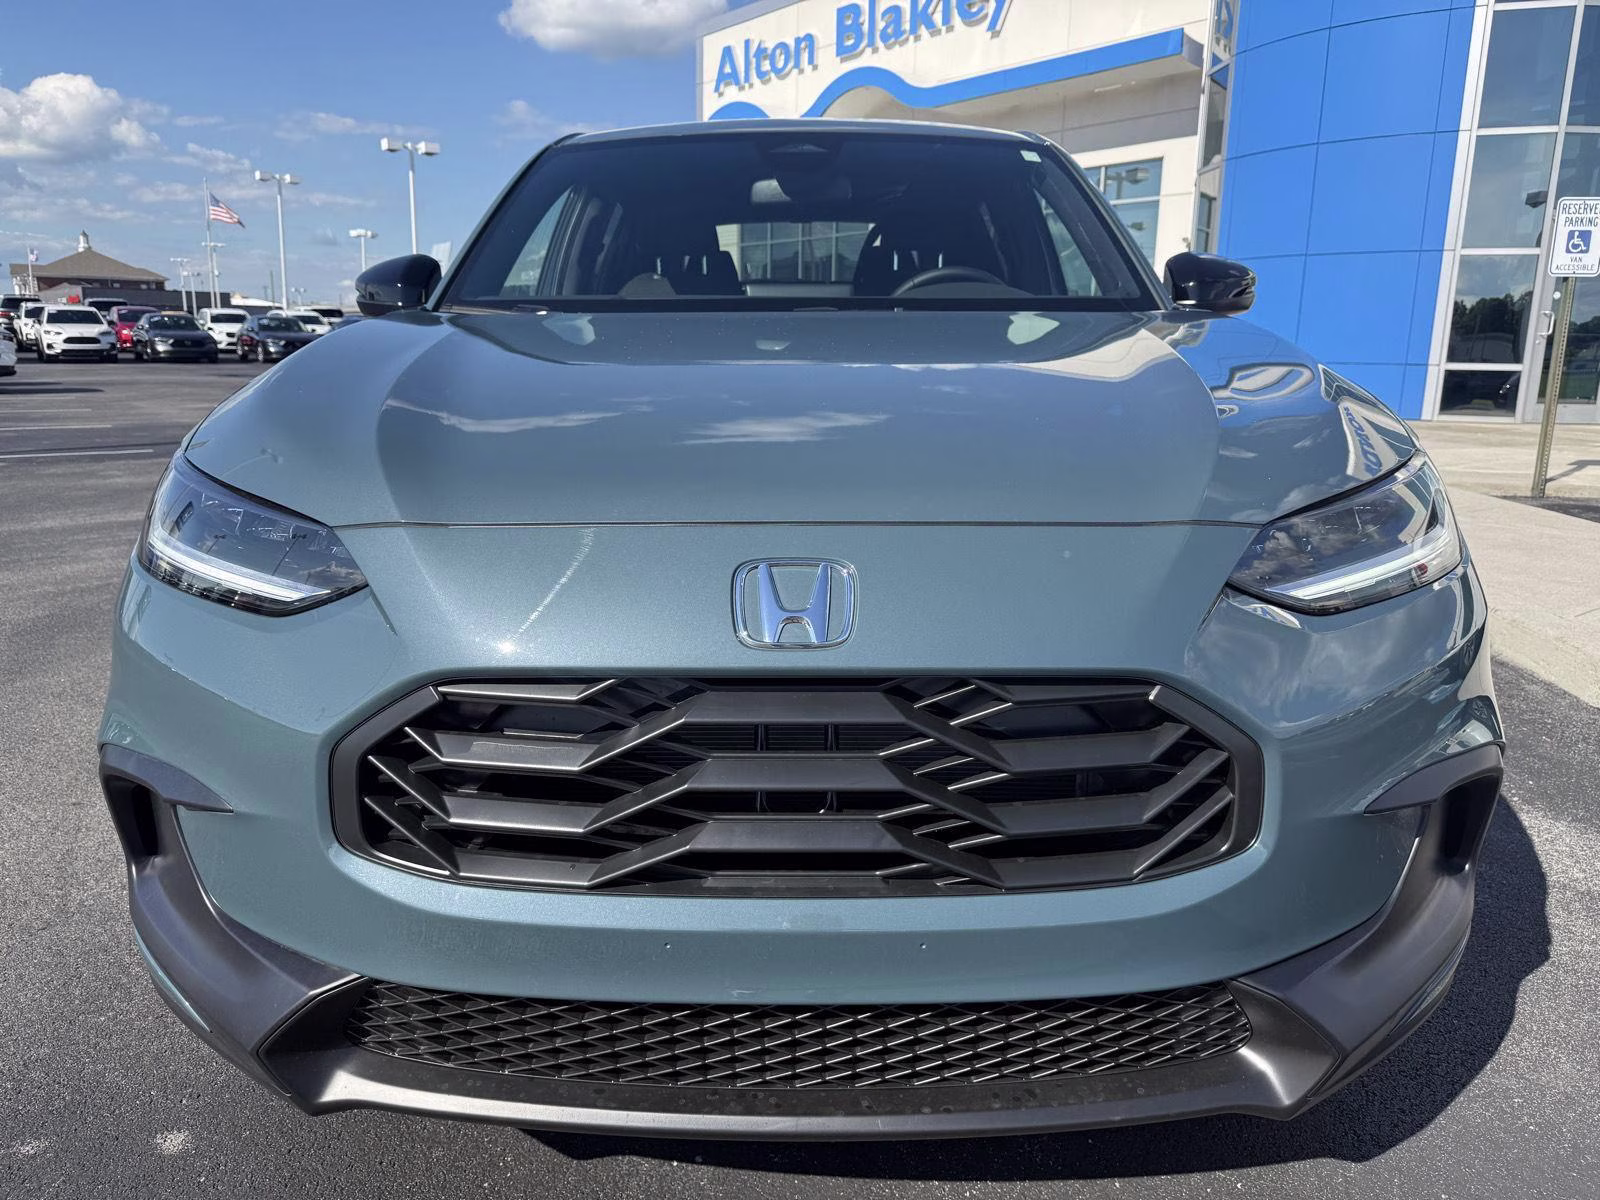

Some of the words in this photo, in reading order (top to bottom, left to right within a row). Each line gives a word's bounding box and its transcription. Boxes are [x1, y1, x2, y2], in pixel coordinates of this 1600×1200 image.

[714, 33, 816, 94] Alton
[1561, 203, 1600, 215] RESERVE
[1564, 216, 1599, 228] PARKING
[1555, 263, 1595, 271] ACCESSIBLE
